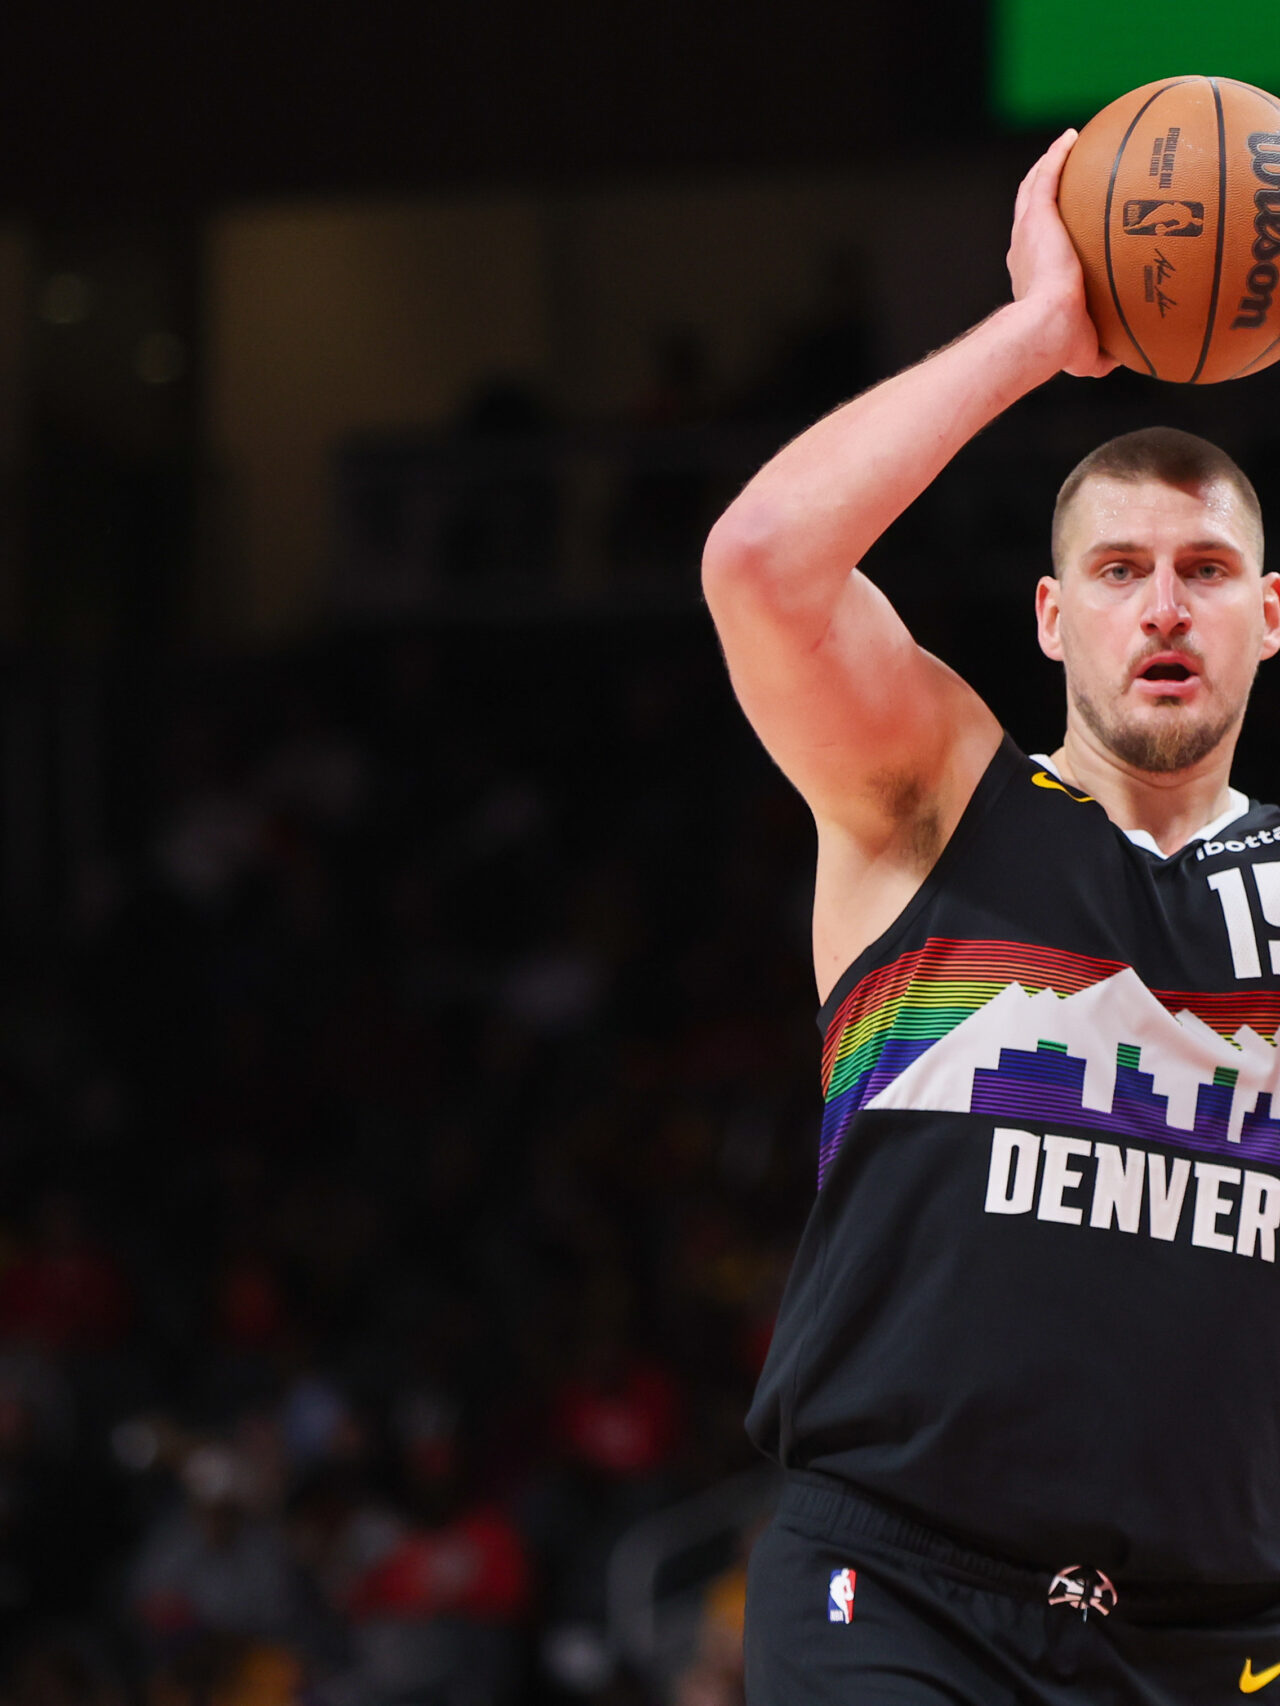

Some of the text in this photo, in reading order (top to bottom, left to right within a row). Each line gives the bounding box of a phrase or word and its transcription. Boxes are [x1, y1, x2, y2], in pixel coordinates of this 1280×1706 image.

[1159, 127, 1181, 189] OFFICIAL GAME BALL
